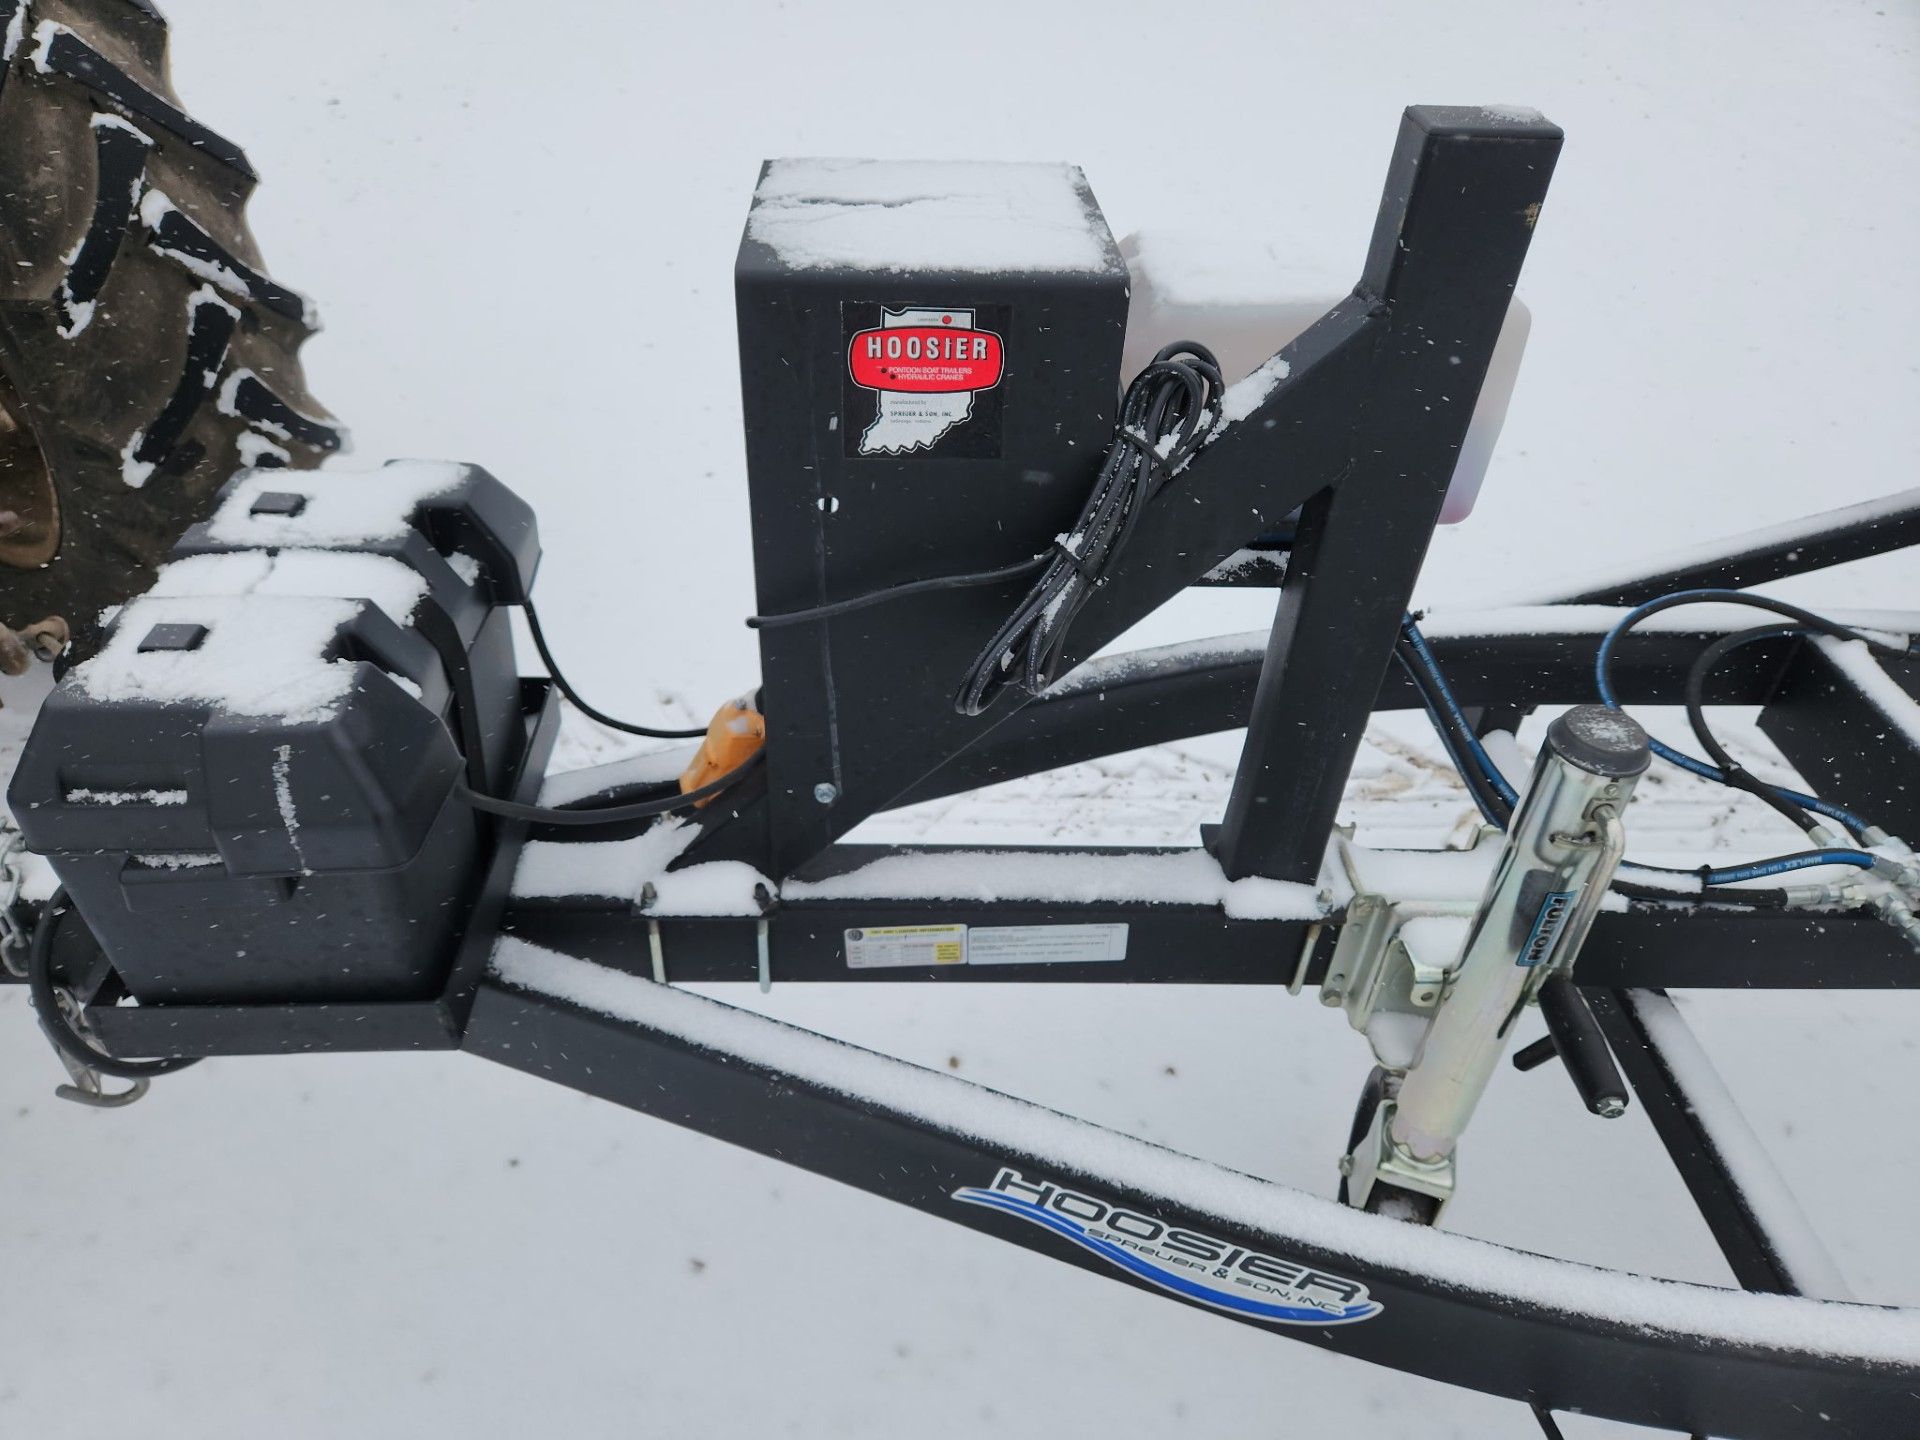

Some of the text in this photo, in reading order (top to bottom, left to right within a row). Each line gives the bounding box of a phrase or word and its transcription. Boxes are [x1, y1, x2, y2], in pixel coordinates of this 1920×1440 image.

[867, 336, 987, 359] HOOSIER
[941, 367, 973, 375] TRAILERS
[1527, 896, 1567, 961] FULTON
[996, 1171, 1361, 1303] HOOSIER
[1212, 1267, 1229, 1280] &
[1234, 1276, 1292, 1301] SON,
[1297, 1296, 1345, 1315] INC.
